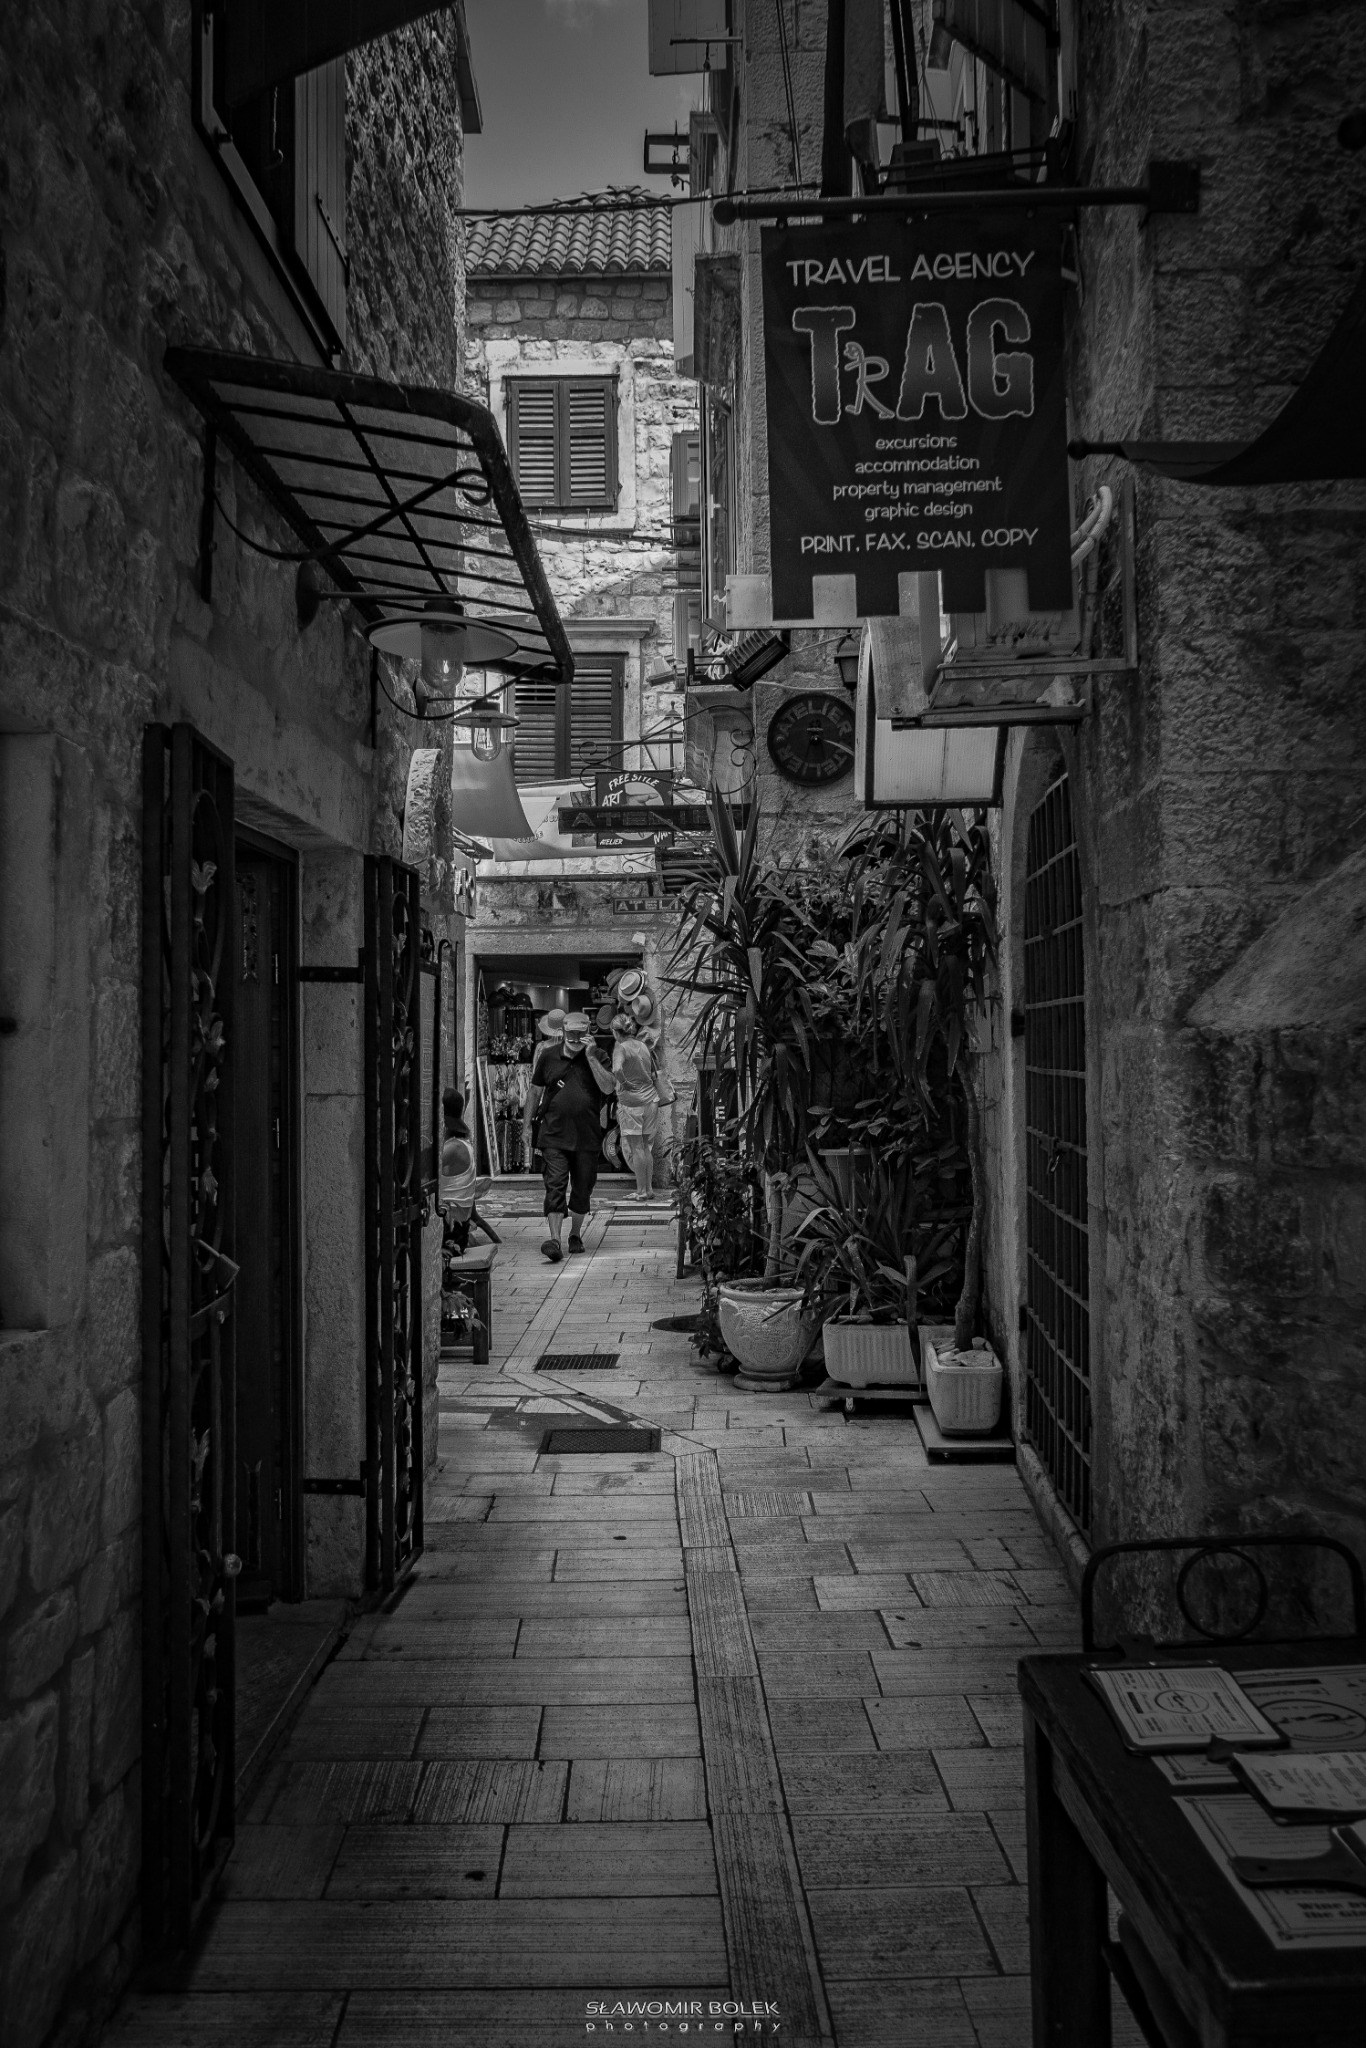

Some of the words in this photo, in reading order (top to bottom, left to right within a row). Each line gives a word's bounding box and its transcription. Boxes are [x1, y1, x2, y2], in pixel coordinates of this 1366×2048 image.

[786, 255, 900, 287] TRAVEL
[911, 251, 1035, 281] AGENCY
[875, 434, 958, 450] excursions
[855, 455, 980, 474] accommodation
[833, 480, 900, 501] property
[903, 476, 1003, 497] management
[864, 502, 920, 522] graphic
[923, 501, 973, 519] design
[981, 527, 1039, 547] COPY
[777, 700, 853, 738] ATELIER
[608, 773, 630, 791] FREE
[601, 790, 624, 807] ART
